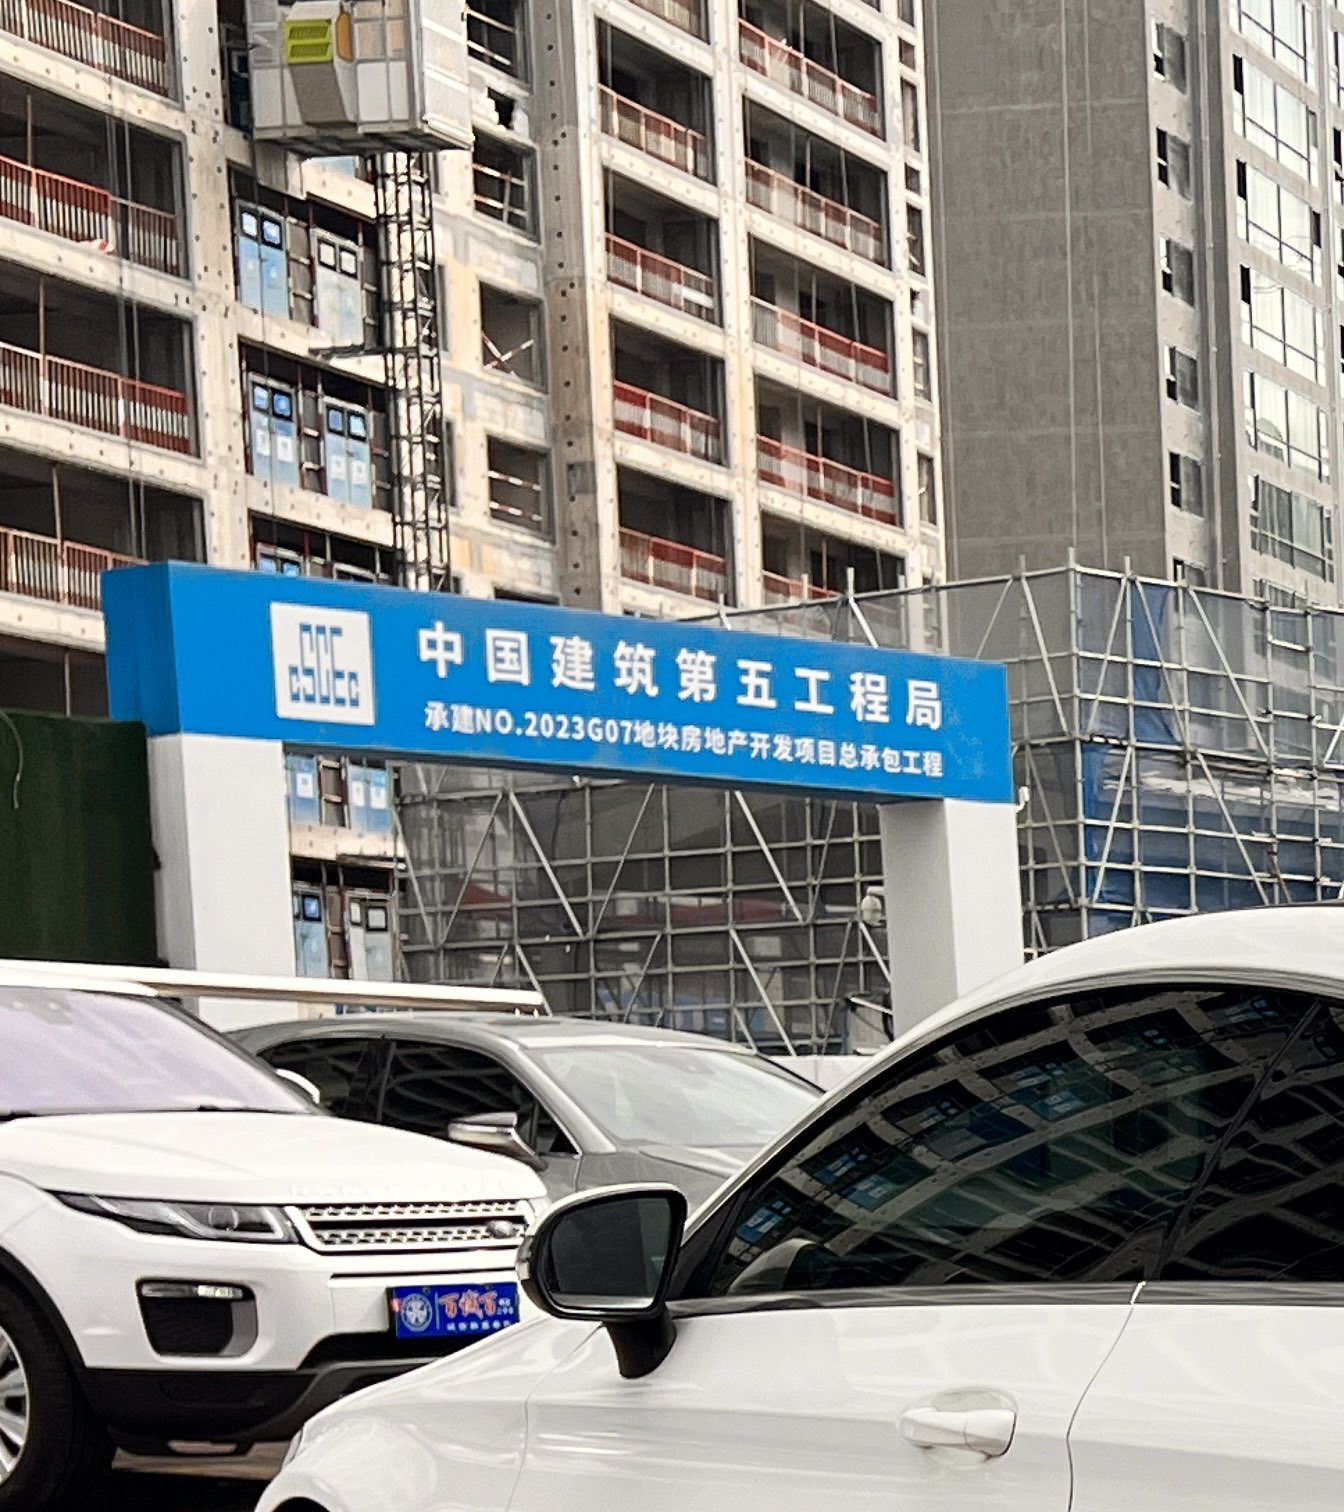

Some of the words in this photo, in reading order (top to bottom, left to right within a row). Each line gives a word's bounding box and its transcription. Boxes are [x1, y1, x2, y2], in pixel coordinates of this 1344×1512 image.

[417, 620, 943, 731] 中国建筑第五工程局
[423, 701, 944, 778] 承建NO.2023G07地块房地产开发项目总承包工程
